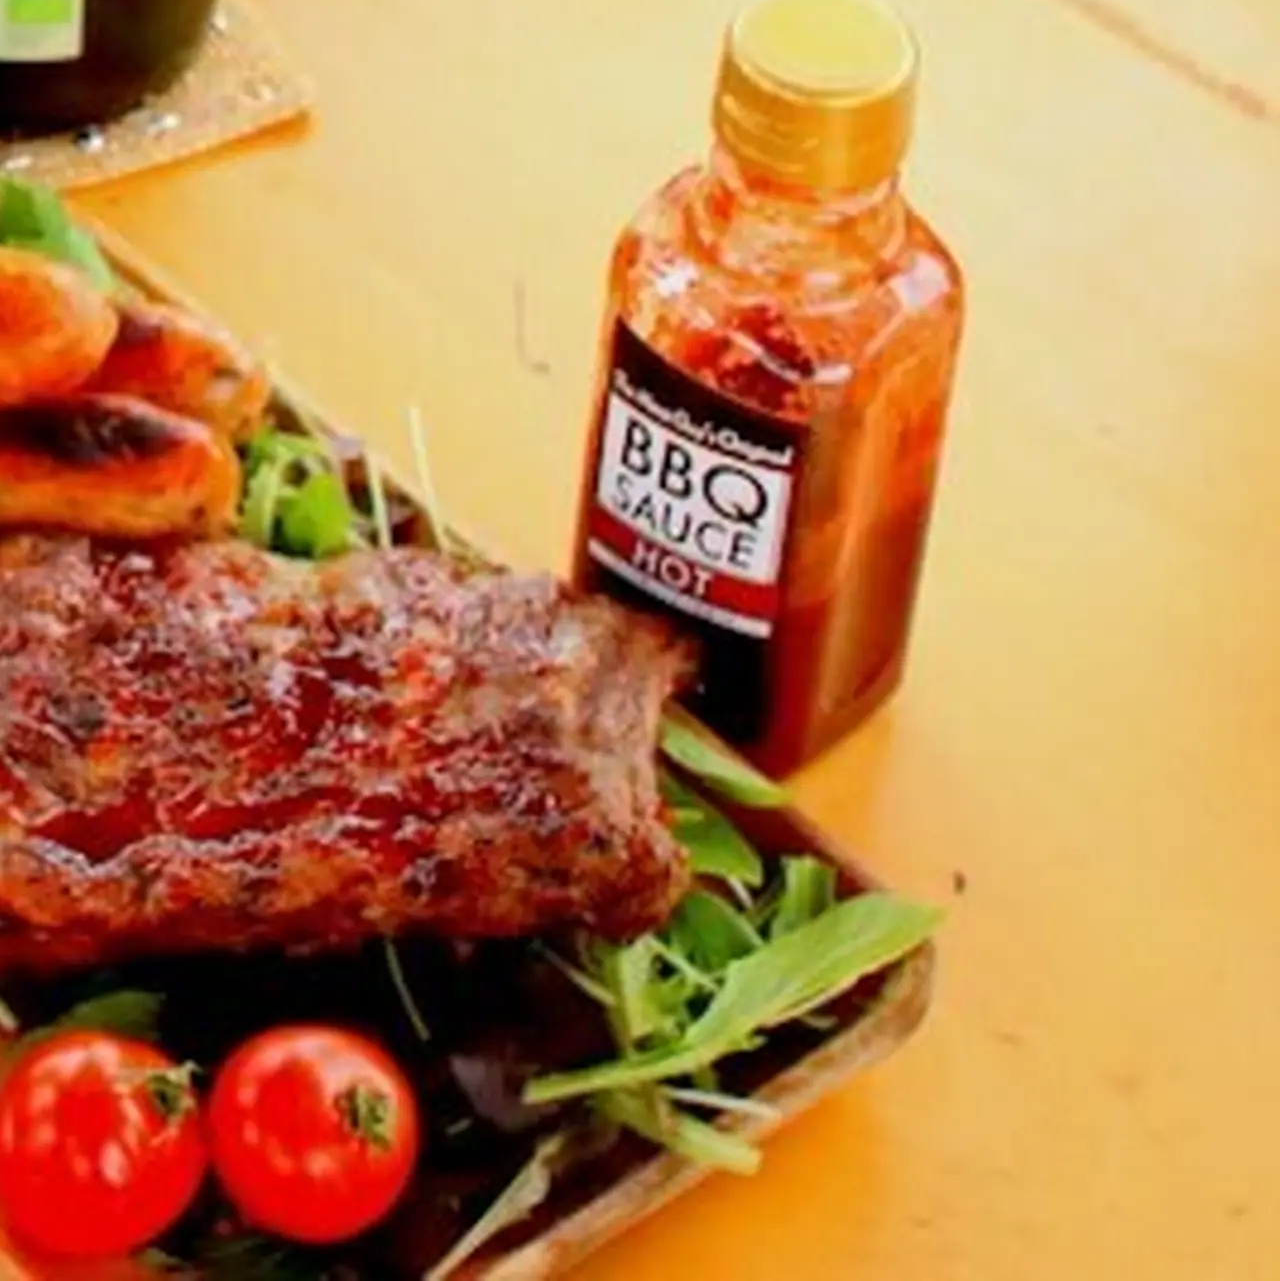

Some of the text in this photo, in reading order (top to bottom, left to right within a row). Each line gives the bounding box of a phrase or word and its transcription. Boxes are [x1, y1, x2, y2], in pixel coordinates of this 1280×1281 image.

[622, 418, 768, 529] BBQ
[614, 474, 758, 569] SAUCE
[634, 540, 715, 597] HOT
